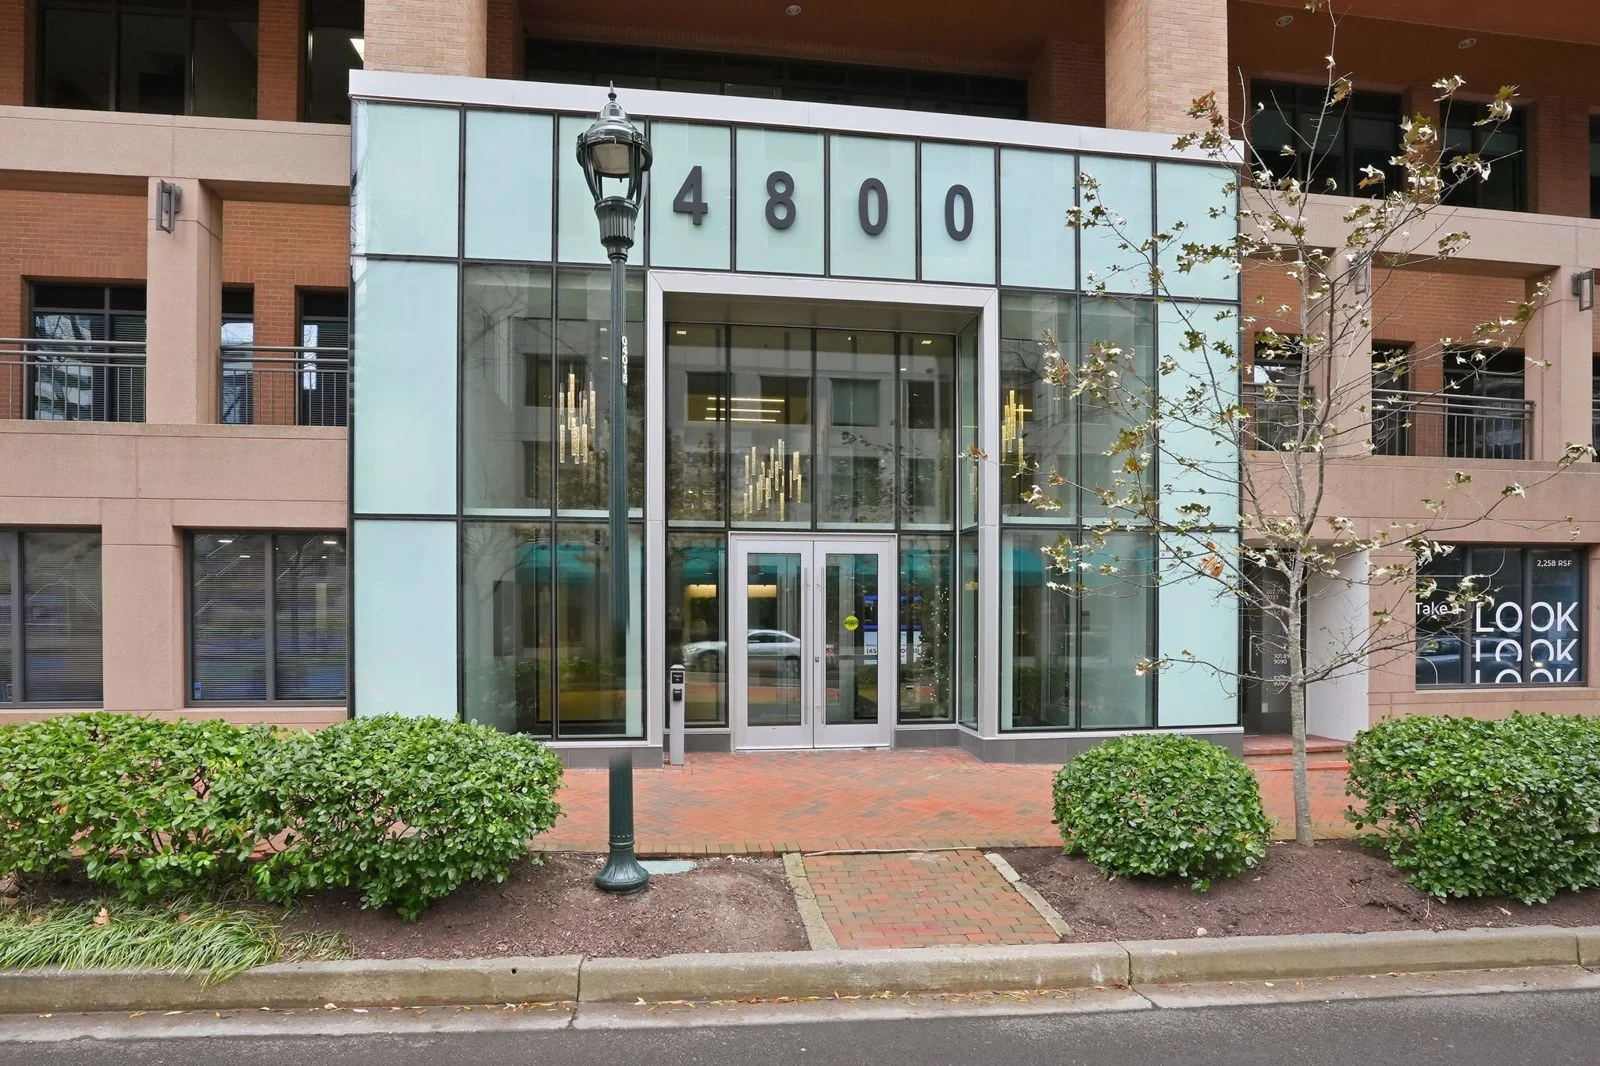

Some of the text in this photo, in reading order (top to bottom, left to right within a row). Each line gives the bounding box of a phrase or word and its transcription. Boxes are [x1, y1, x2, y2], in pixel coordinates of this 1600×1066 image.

[1537, 559, 1572, 568] 2,258 RSF
[1416, 602, 1448, 615] Take
[1475, 601, 1579, 632] LOOK
